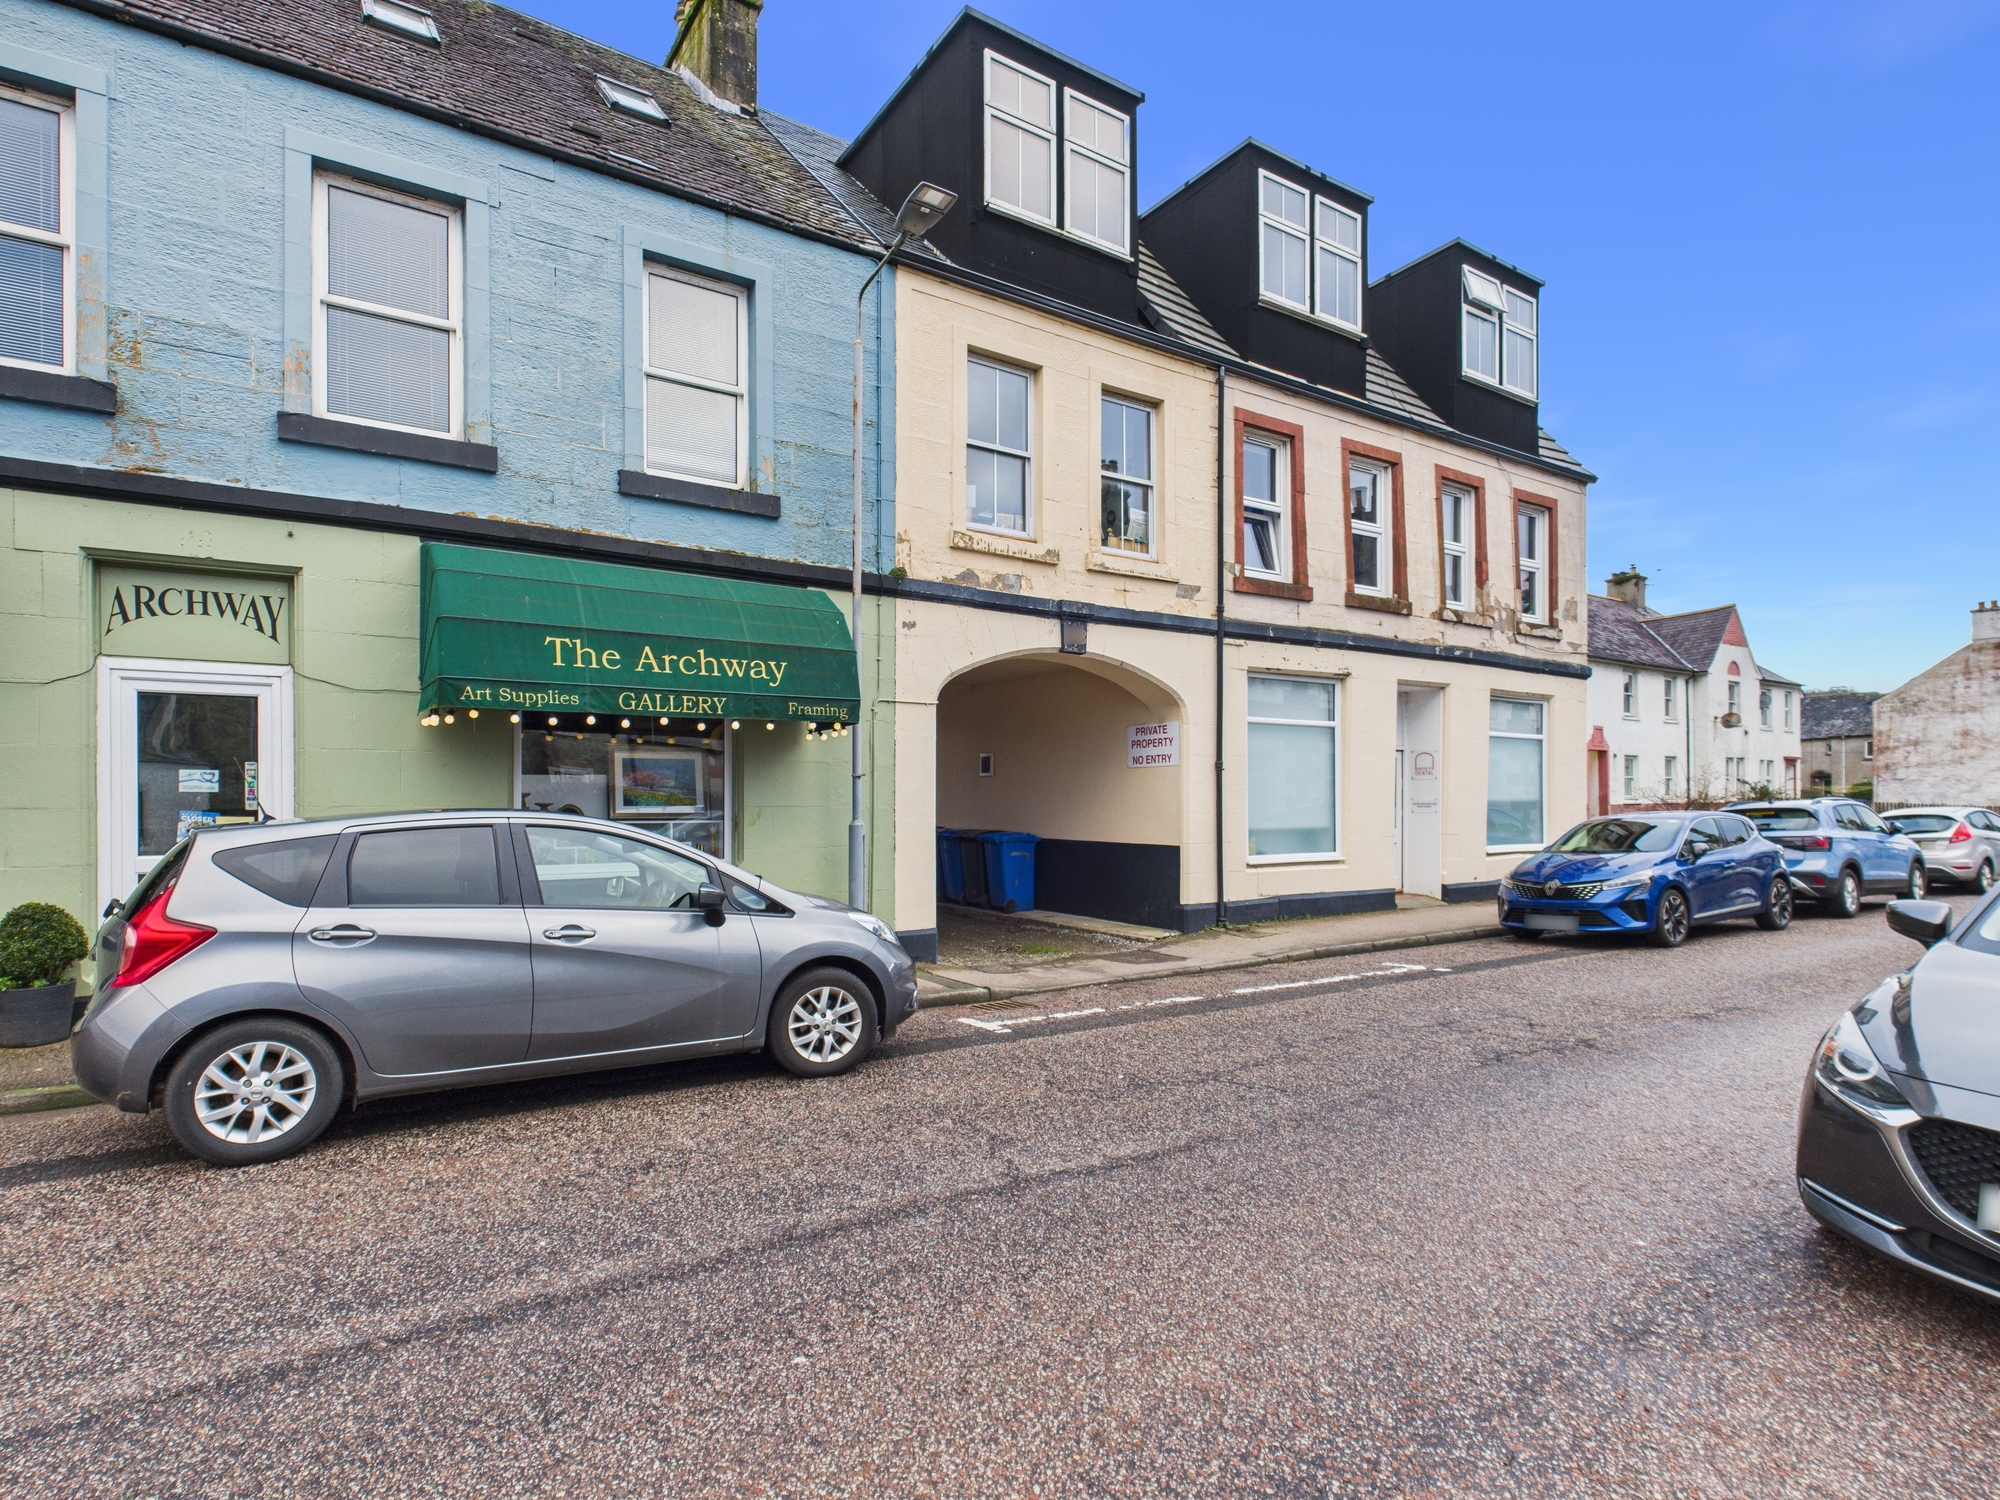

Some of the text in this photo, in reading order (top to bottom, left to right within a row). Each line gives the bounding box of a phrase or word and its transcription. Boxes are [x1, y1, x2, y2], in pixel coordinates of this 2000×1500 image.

[104, 584, 286, 645] ARCHWAY
[544, 636, 788, 688] The Archway
[460, 685, 579, 706] Art Supplies
[618, 691, 727, 715] GALLERY
[788, 702, 849, 721] Framing
[1135, 725, 1168, 736] PRIVATE
[1131, 737, 1174, 749] PROPERTY
[1132, 754, 1172, 765] NO ENTRY
[1010, 851, 1031, 887] 7
